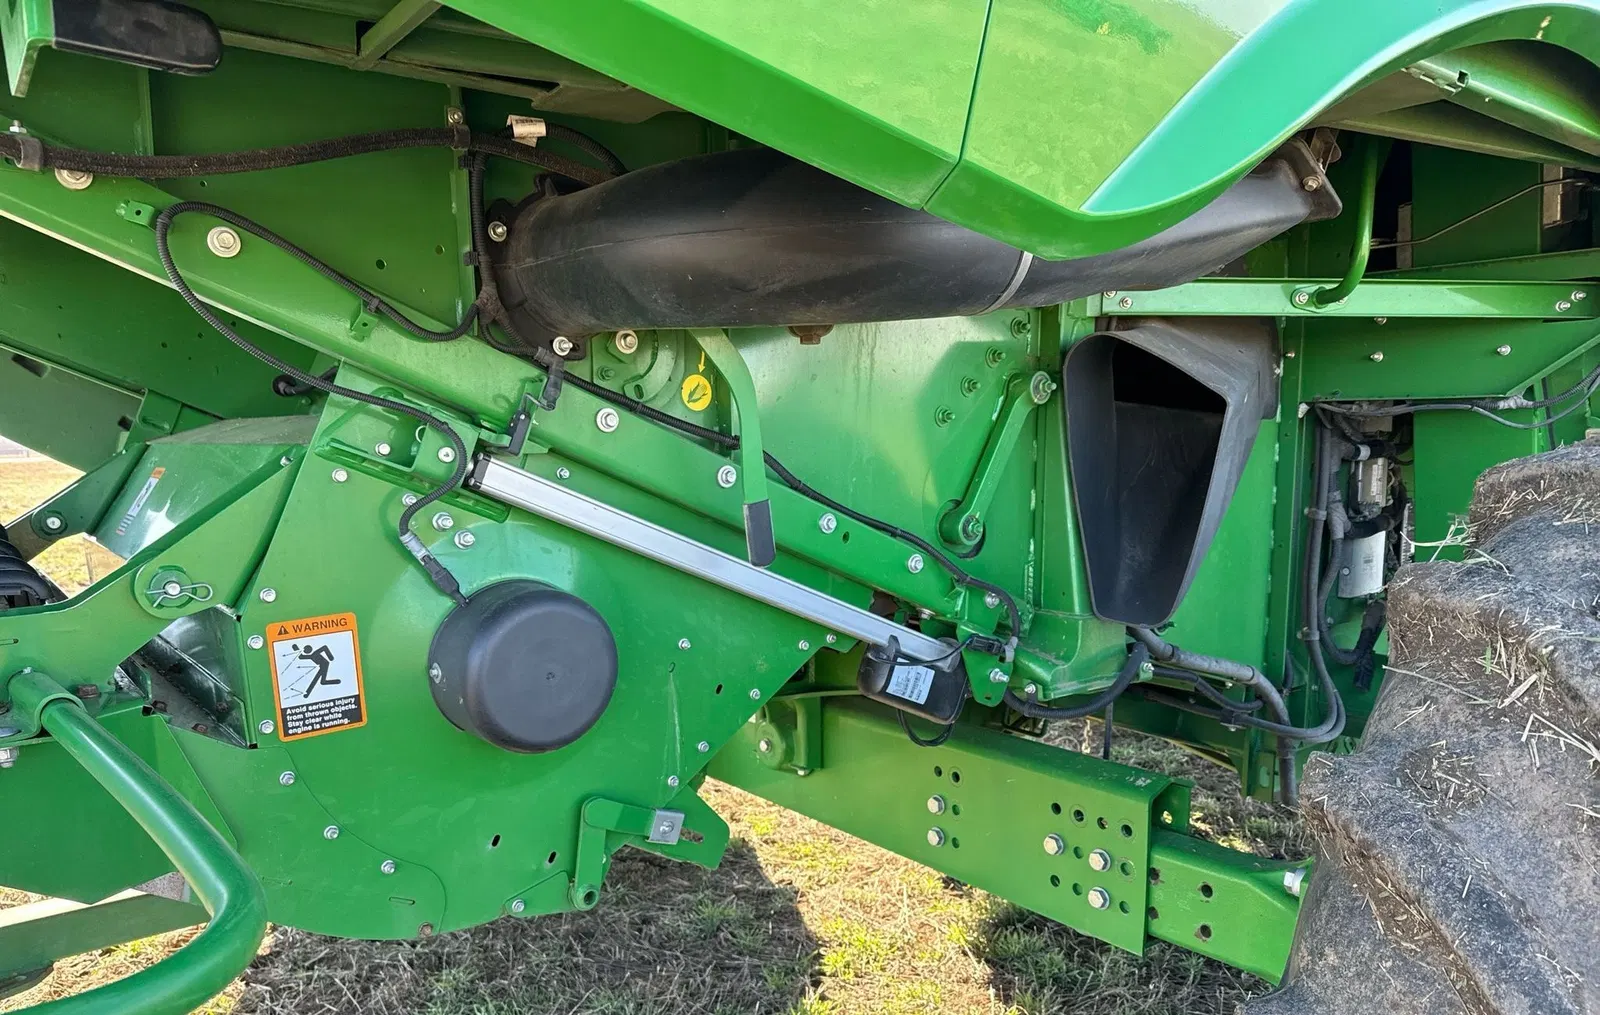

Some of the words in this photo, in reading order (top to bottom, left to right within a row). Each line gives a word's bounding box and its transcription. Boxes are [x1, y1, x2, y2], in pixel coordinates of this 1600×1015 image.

[292, 617, 348, 633] WARNING
[286, 706, 307, 715] Avoid
[308, 701, 334, 711] serious
[335, 697, 355, 706] injury
[286, 713, 304, 721] from
[304, 708, 329, 718] thrown
[330, 703, 358, 713] objects.
[287, 720, 304, 728] Stay
[305, 716, 323, 724] clear
[323, 712, 342, 720] while
[288, 724, 313, 734] engine
[313, 722, 321, 730] is
[321, 718, 351, 728] running.
